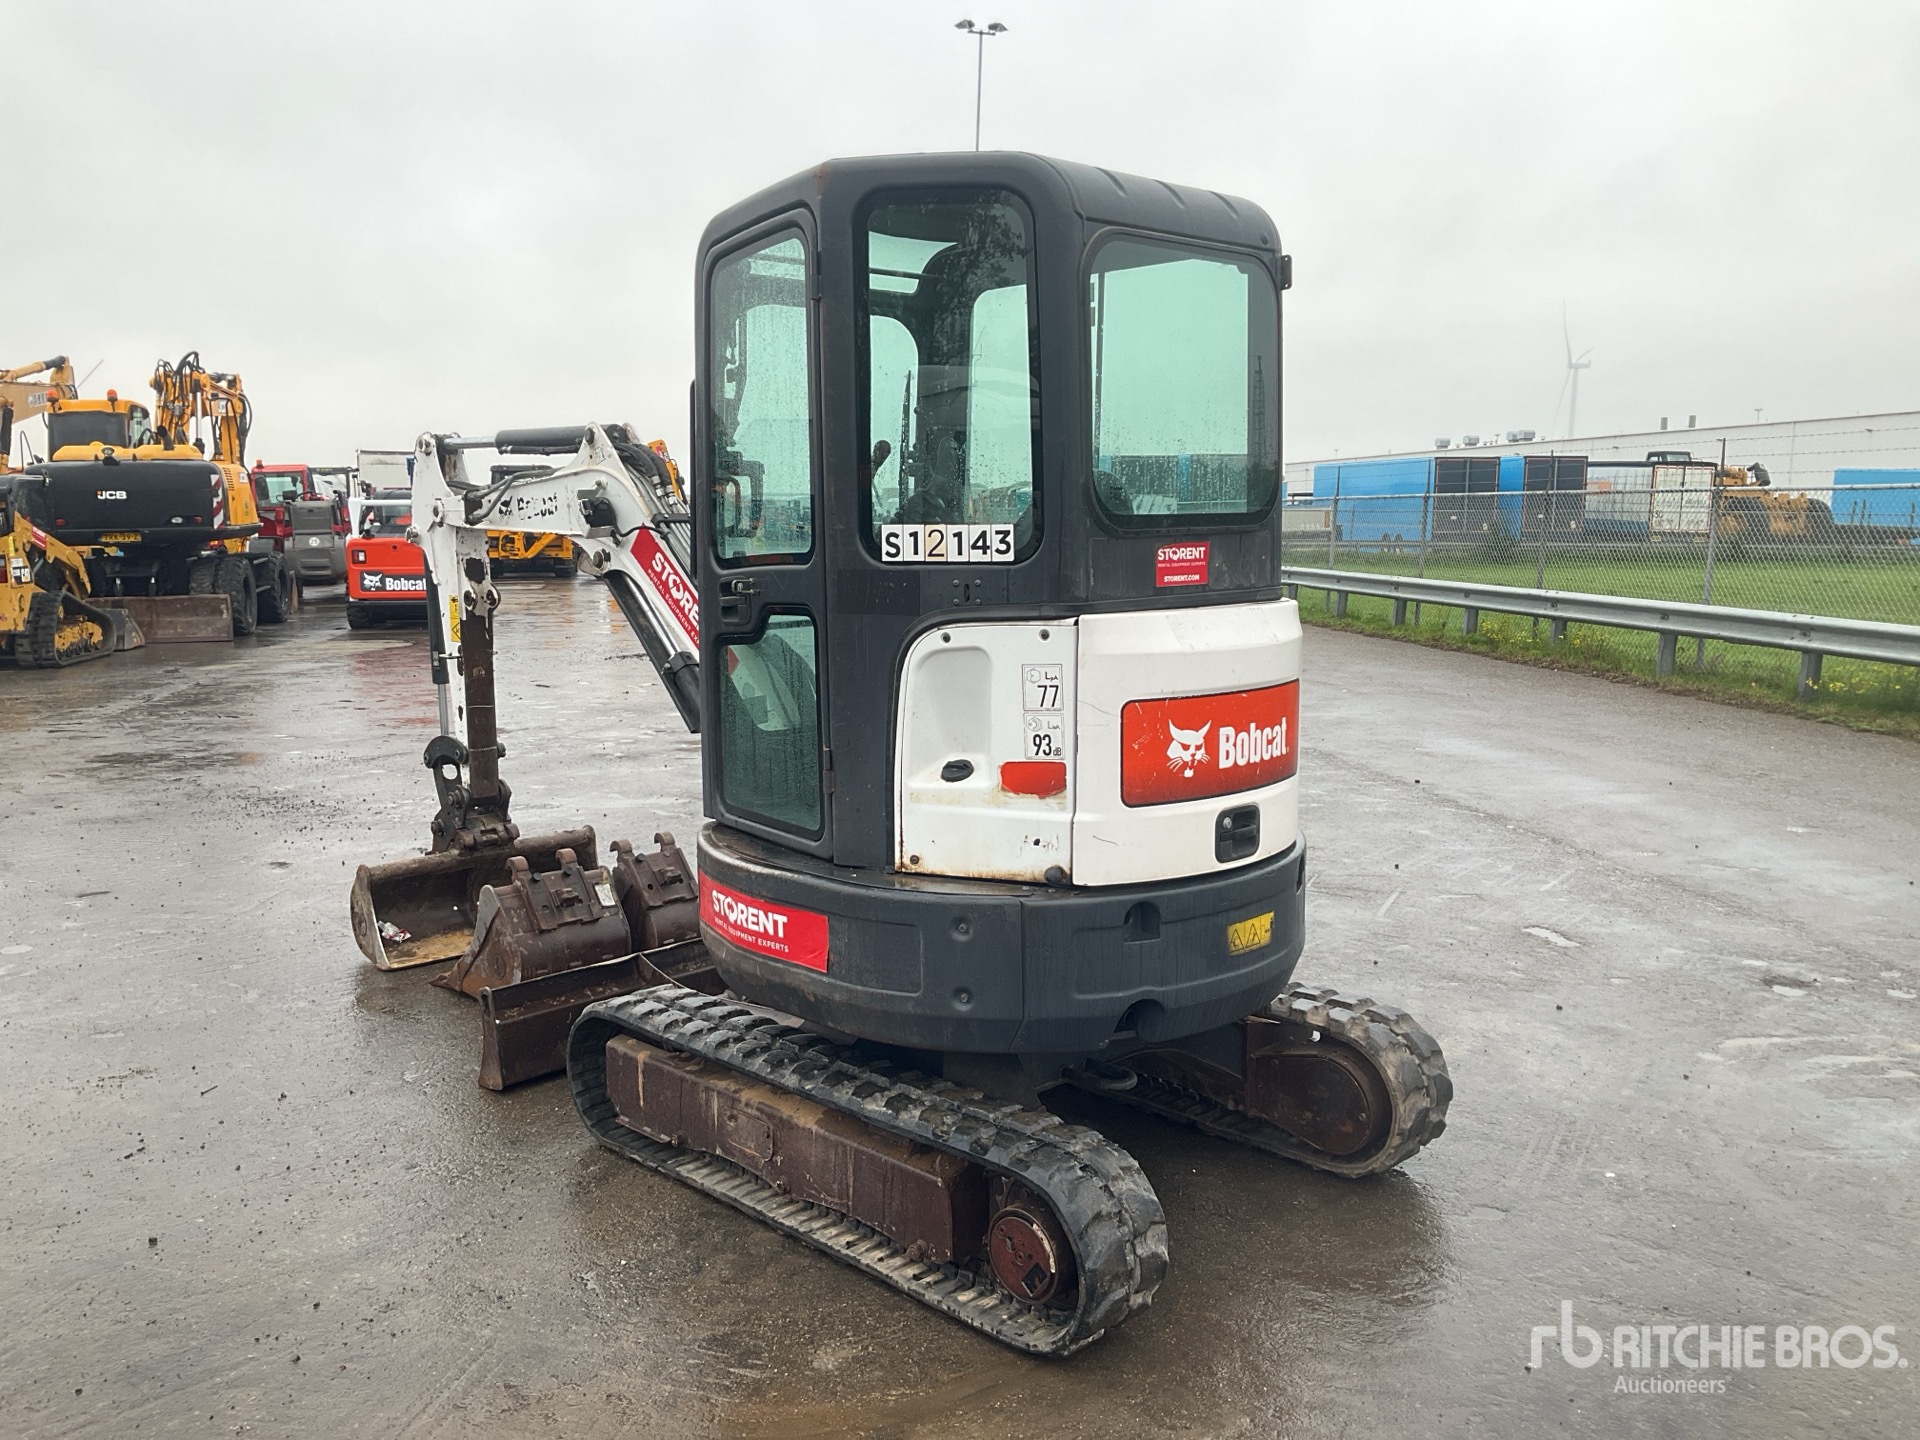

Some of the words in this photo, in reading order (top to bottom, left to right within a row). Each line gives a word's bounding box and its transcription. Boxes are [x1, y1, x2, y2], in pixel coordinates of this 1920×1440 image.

[96, 490, 127, 499] JCB
[884, 528, 1012, 558] S12143
[1157, 547, 1206, 561] STORENT
[652, 552, 699, 631] STORE
[1164, 574, 1200, 583] STORENT.COM
[647, 568, 666, 594] RENTAL
[665, 593, 691, 630] EQUIPMENT
[1037, 685, 1059, 708] 77
[1032, 733, 1053, 756] 93
[1219, 716, 1287, 770] Bobcat
[711, 889, 788, 938] STORENT
[714, 916, 728, 931] RENTAL
[728, 925, 756, 944] EQUIPMENT
[757, 938, 789, 953] EXPERTS
